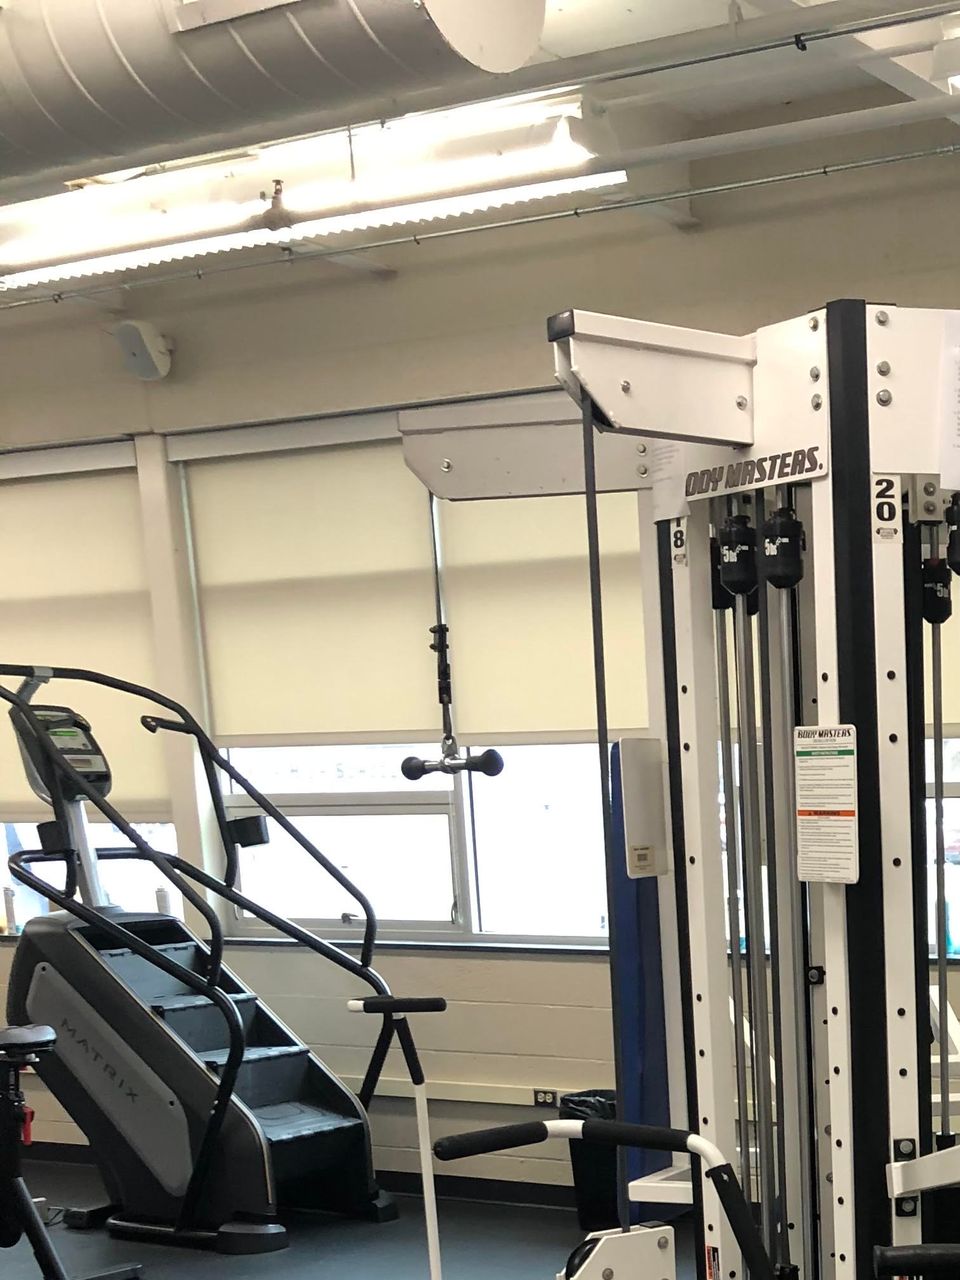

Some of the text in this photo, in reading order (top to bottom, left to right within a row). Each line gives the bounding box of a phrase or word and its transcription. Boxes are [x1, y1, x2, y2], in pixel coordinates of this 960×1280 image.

[686, 467, 724, 497] ODY
[875, 478, 896, 522] 20
[61, 1018, 138, 1103] MATRIX
